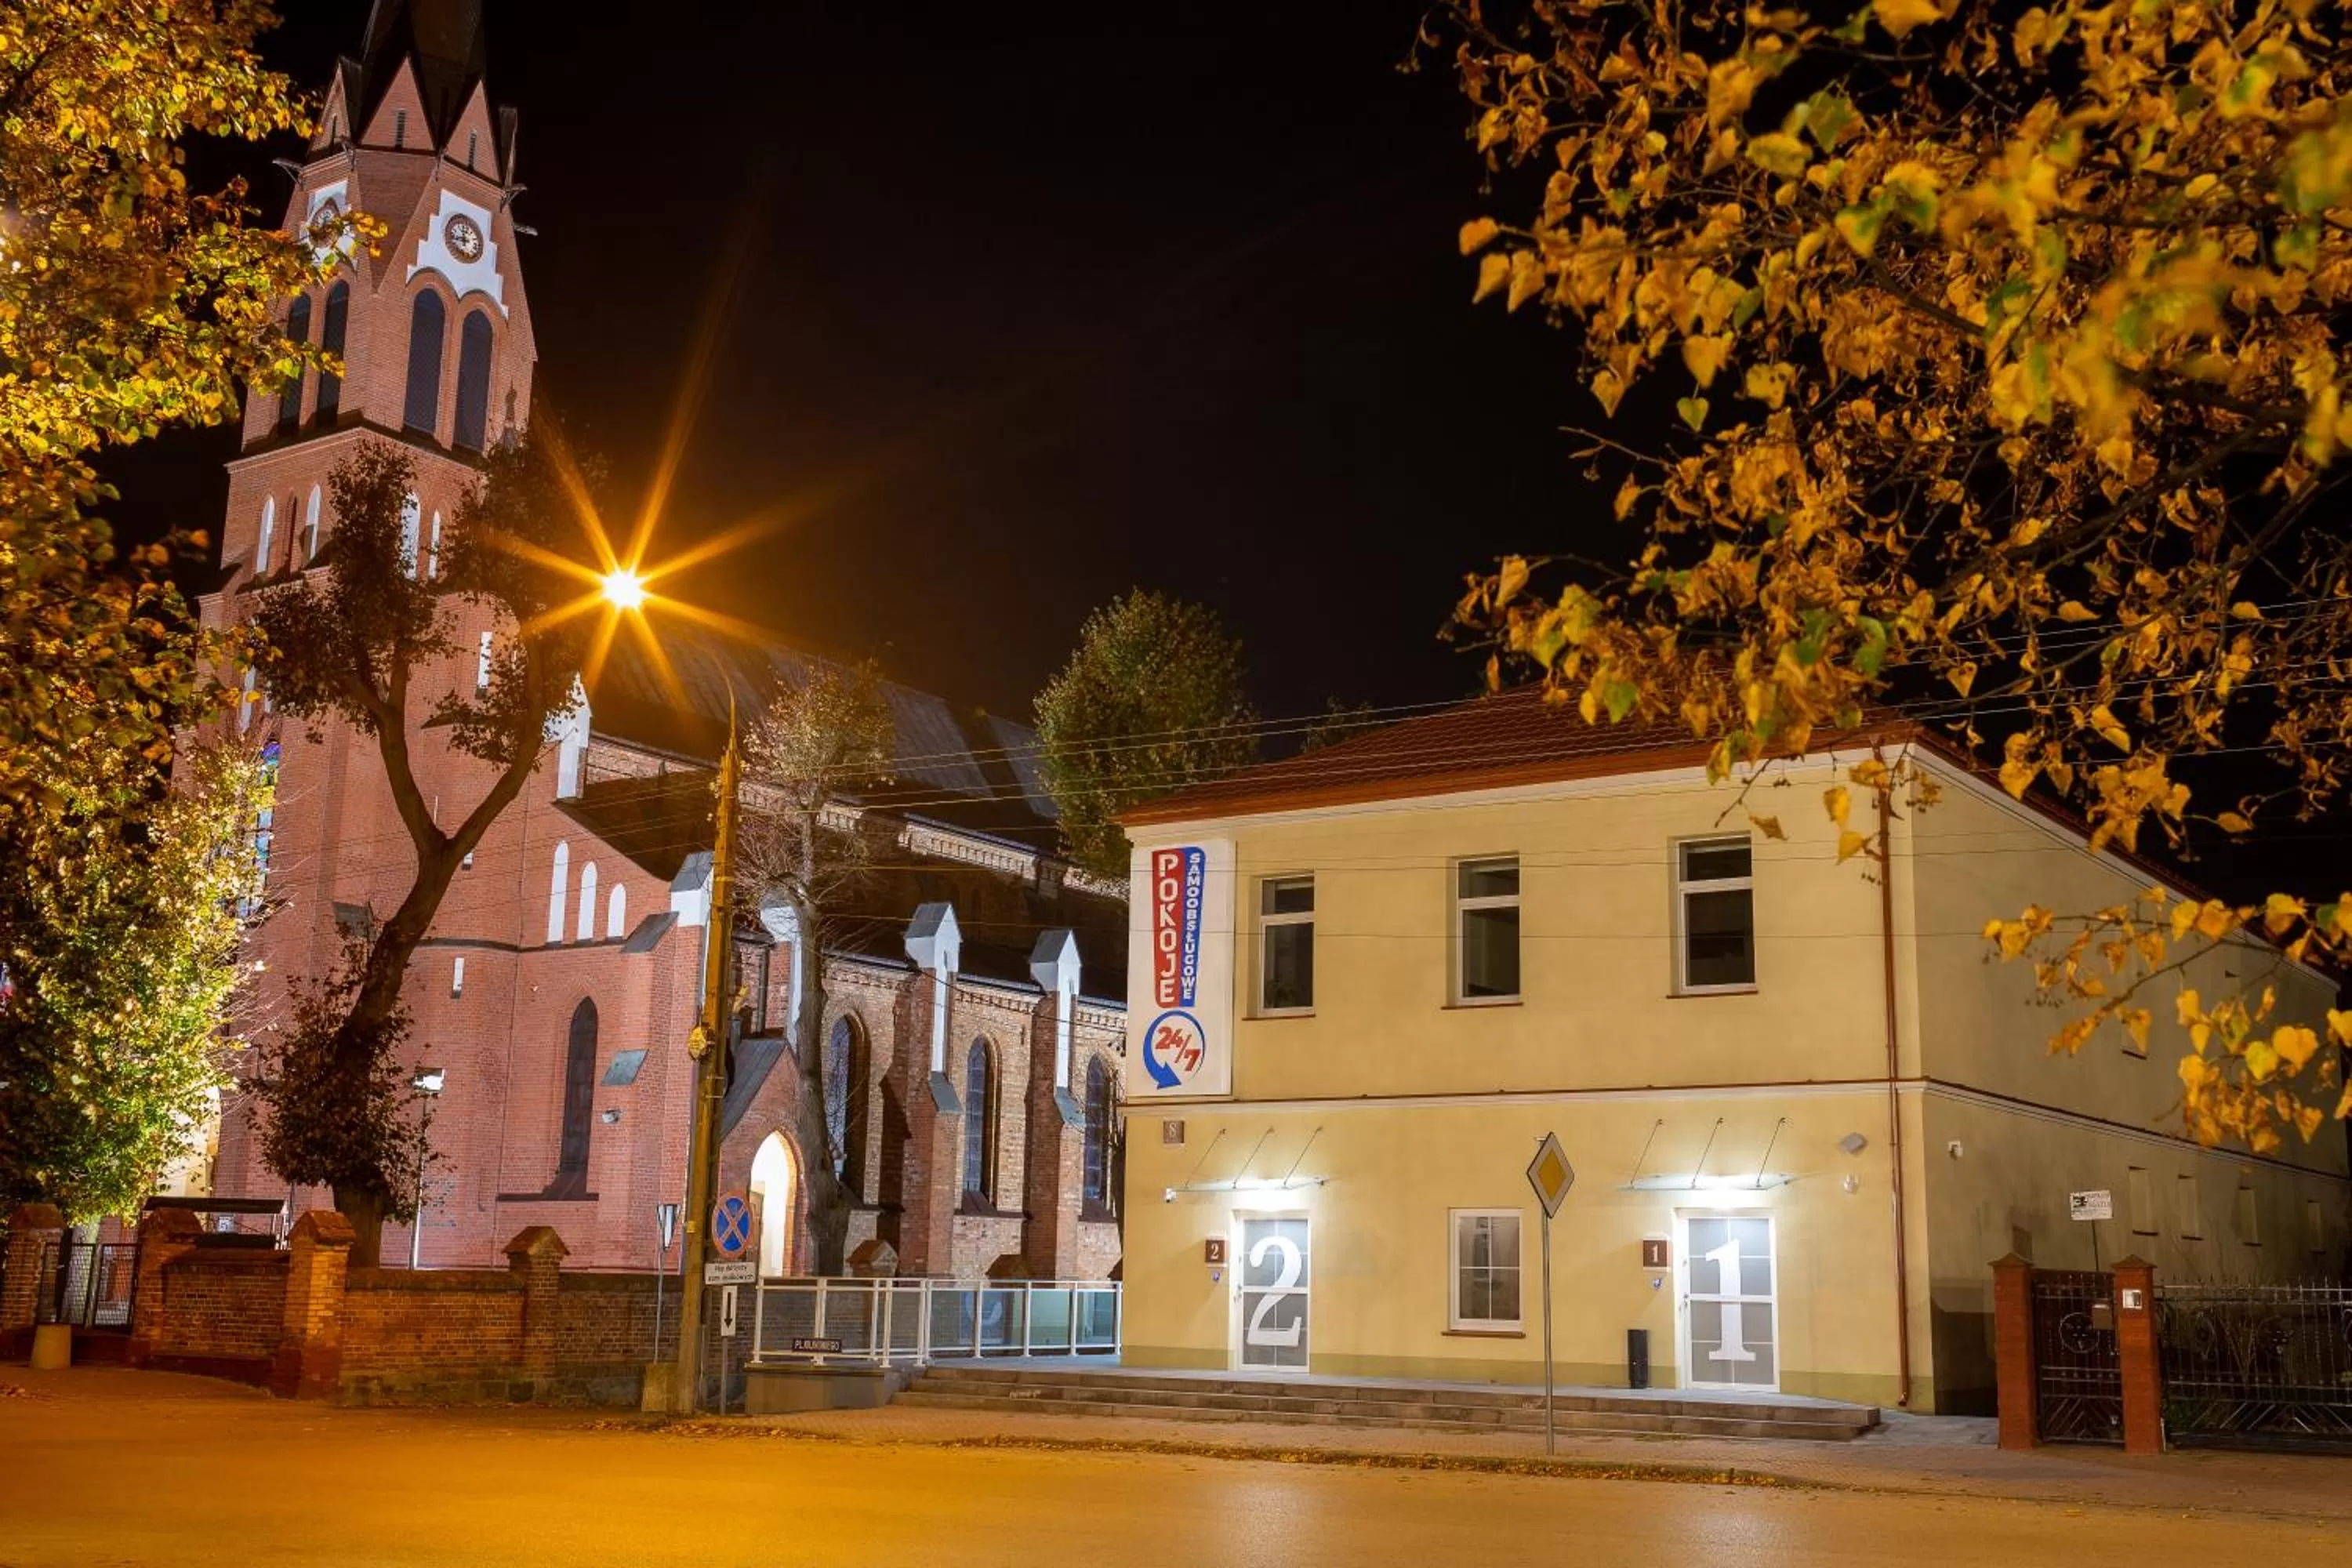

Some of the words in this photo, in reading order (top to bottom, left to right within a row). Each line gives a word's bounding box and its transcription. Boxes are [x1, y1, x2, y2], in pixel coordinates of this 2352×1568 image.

[1159, 853, 1178, 1003] POKOJE
[1155, 1026, 1201, 1072] 24/7
[1210, 1243, 1219, 1260] 2
[1652, 1243, 1659, 1263] 1
[1247, 1236, 1302, 1347] 2
[1705, 1239, 1756, 1362] 1
